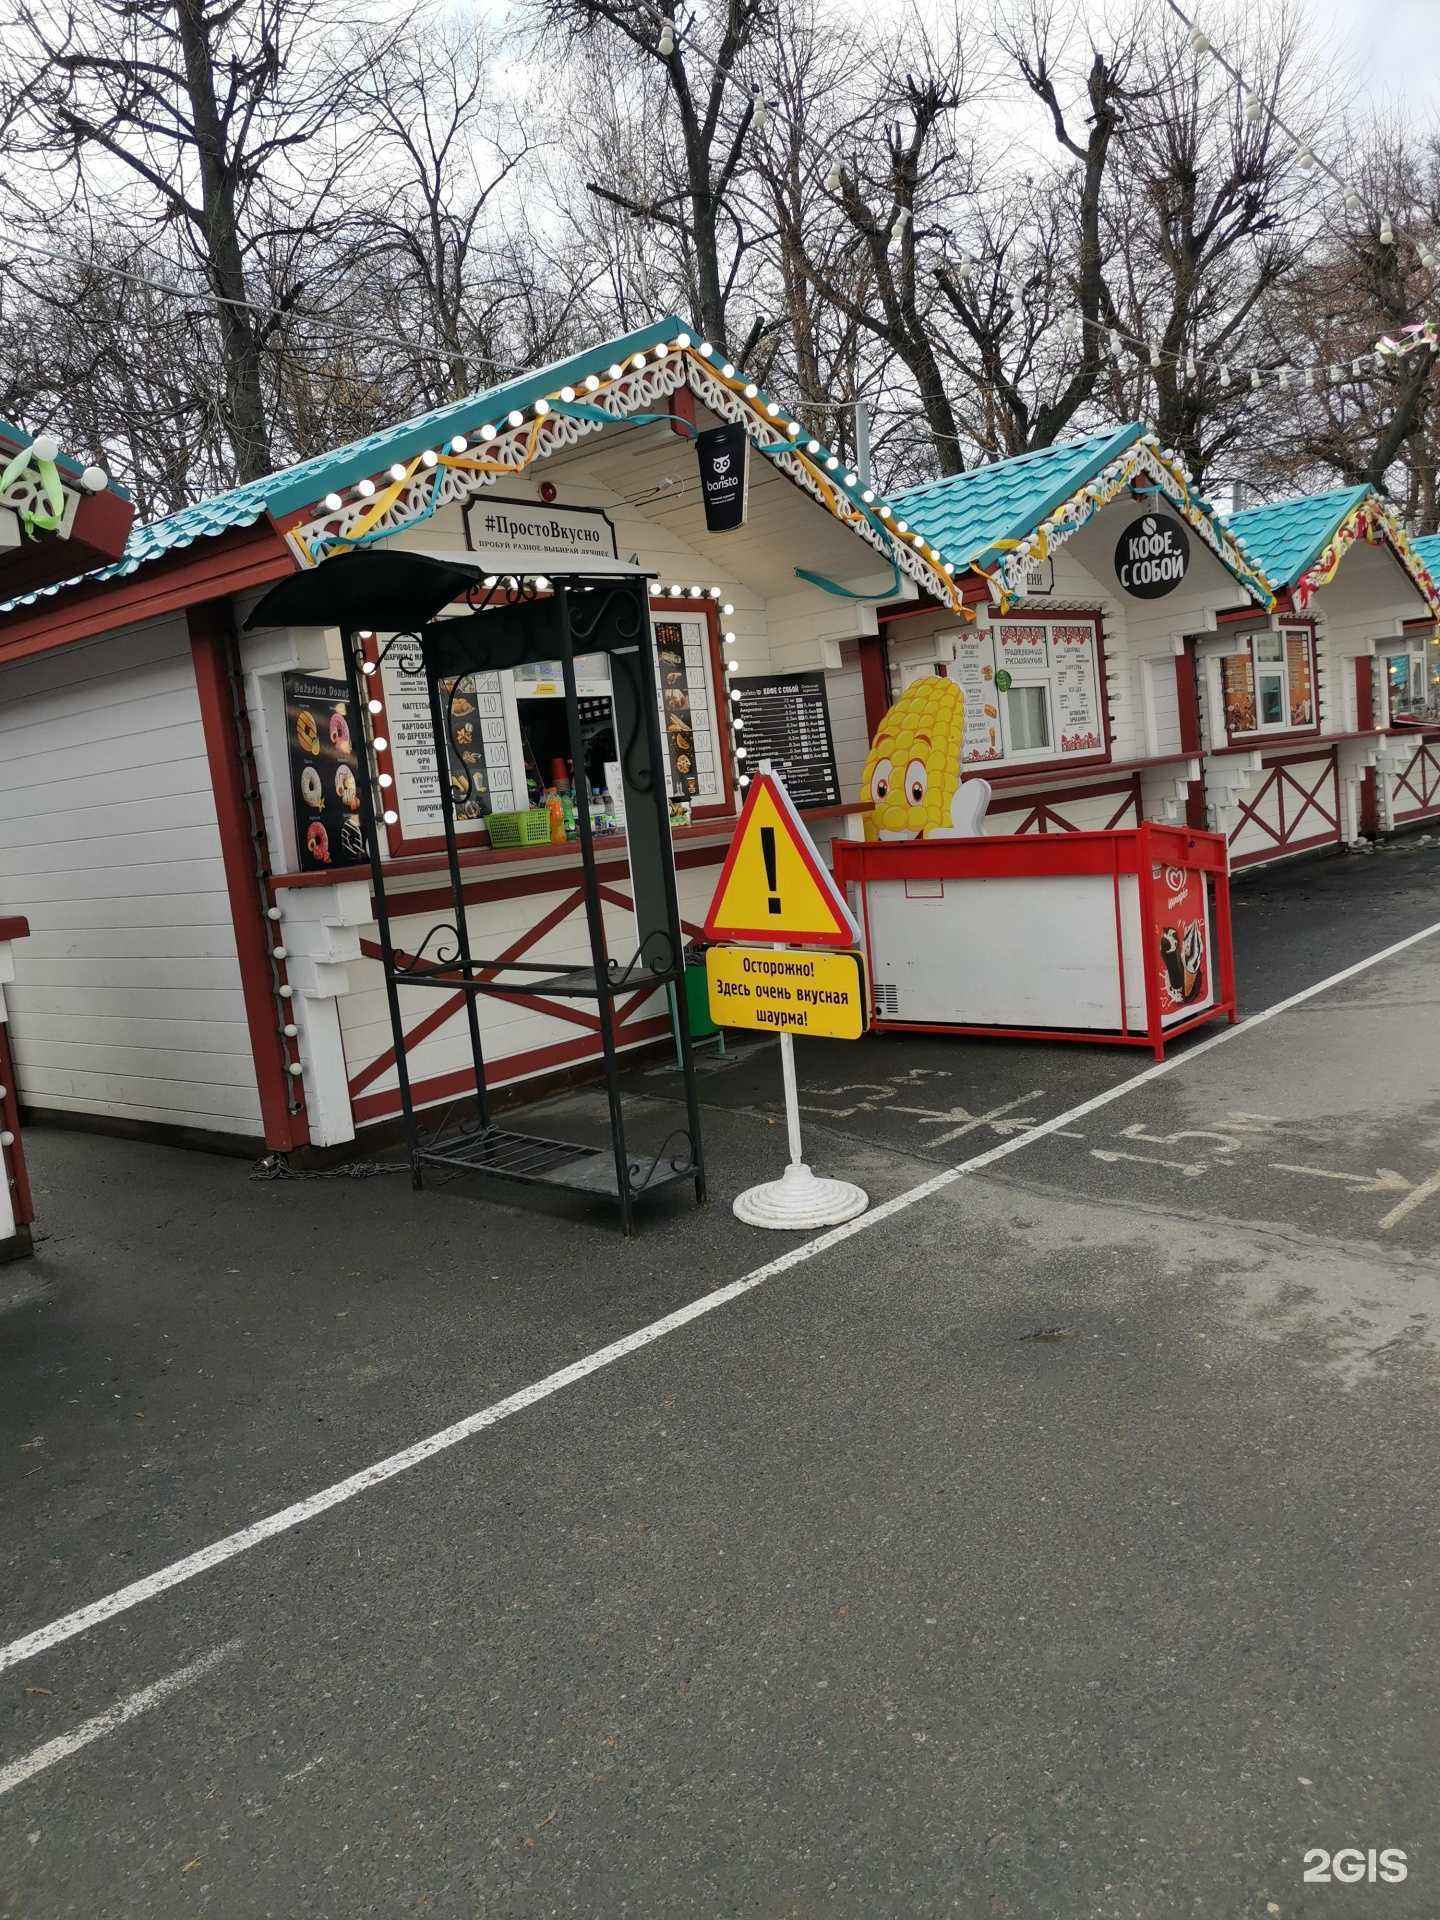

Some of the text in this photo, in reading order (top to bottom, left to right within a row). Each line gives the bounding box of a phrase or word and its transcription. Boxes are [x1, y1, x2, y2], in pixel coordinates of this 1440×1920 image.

[707, 475, 738, 491] barista
[485, 514, 600, 544] #ПростоВкусно
[1128, 531, 1173, 560] КОФЕ
[1121, 549, 1184, 587] С СОБОЙ
[743, 957, 815, 977] Осторожно!
[716, 979, 849, 1005] Здесь очень вкусная
[756, 1009, 808, 1027] шаурма!
